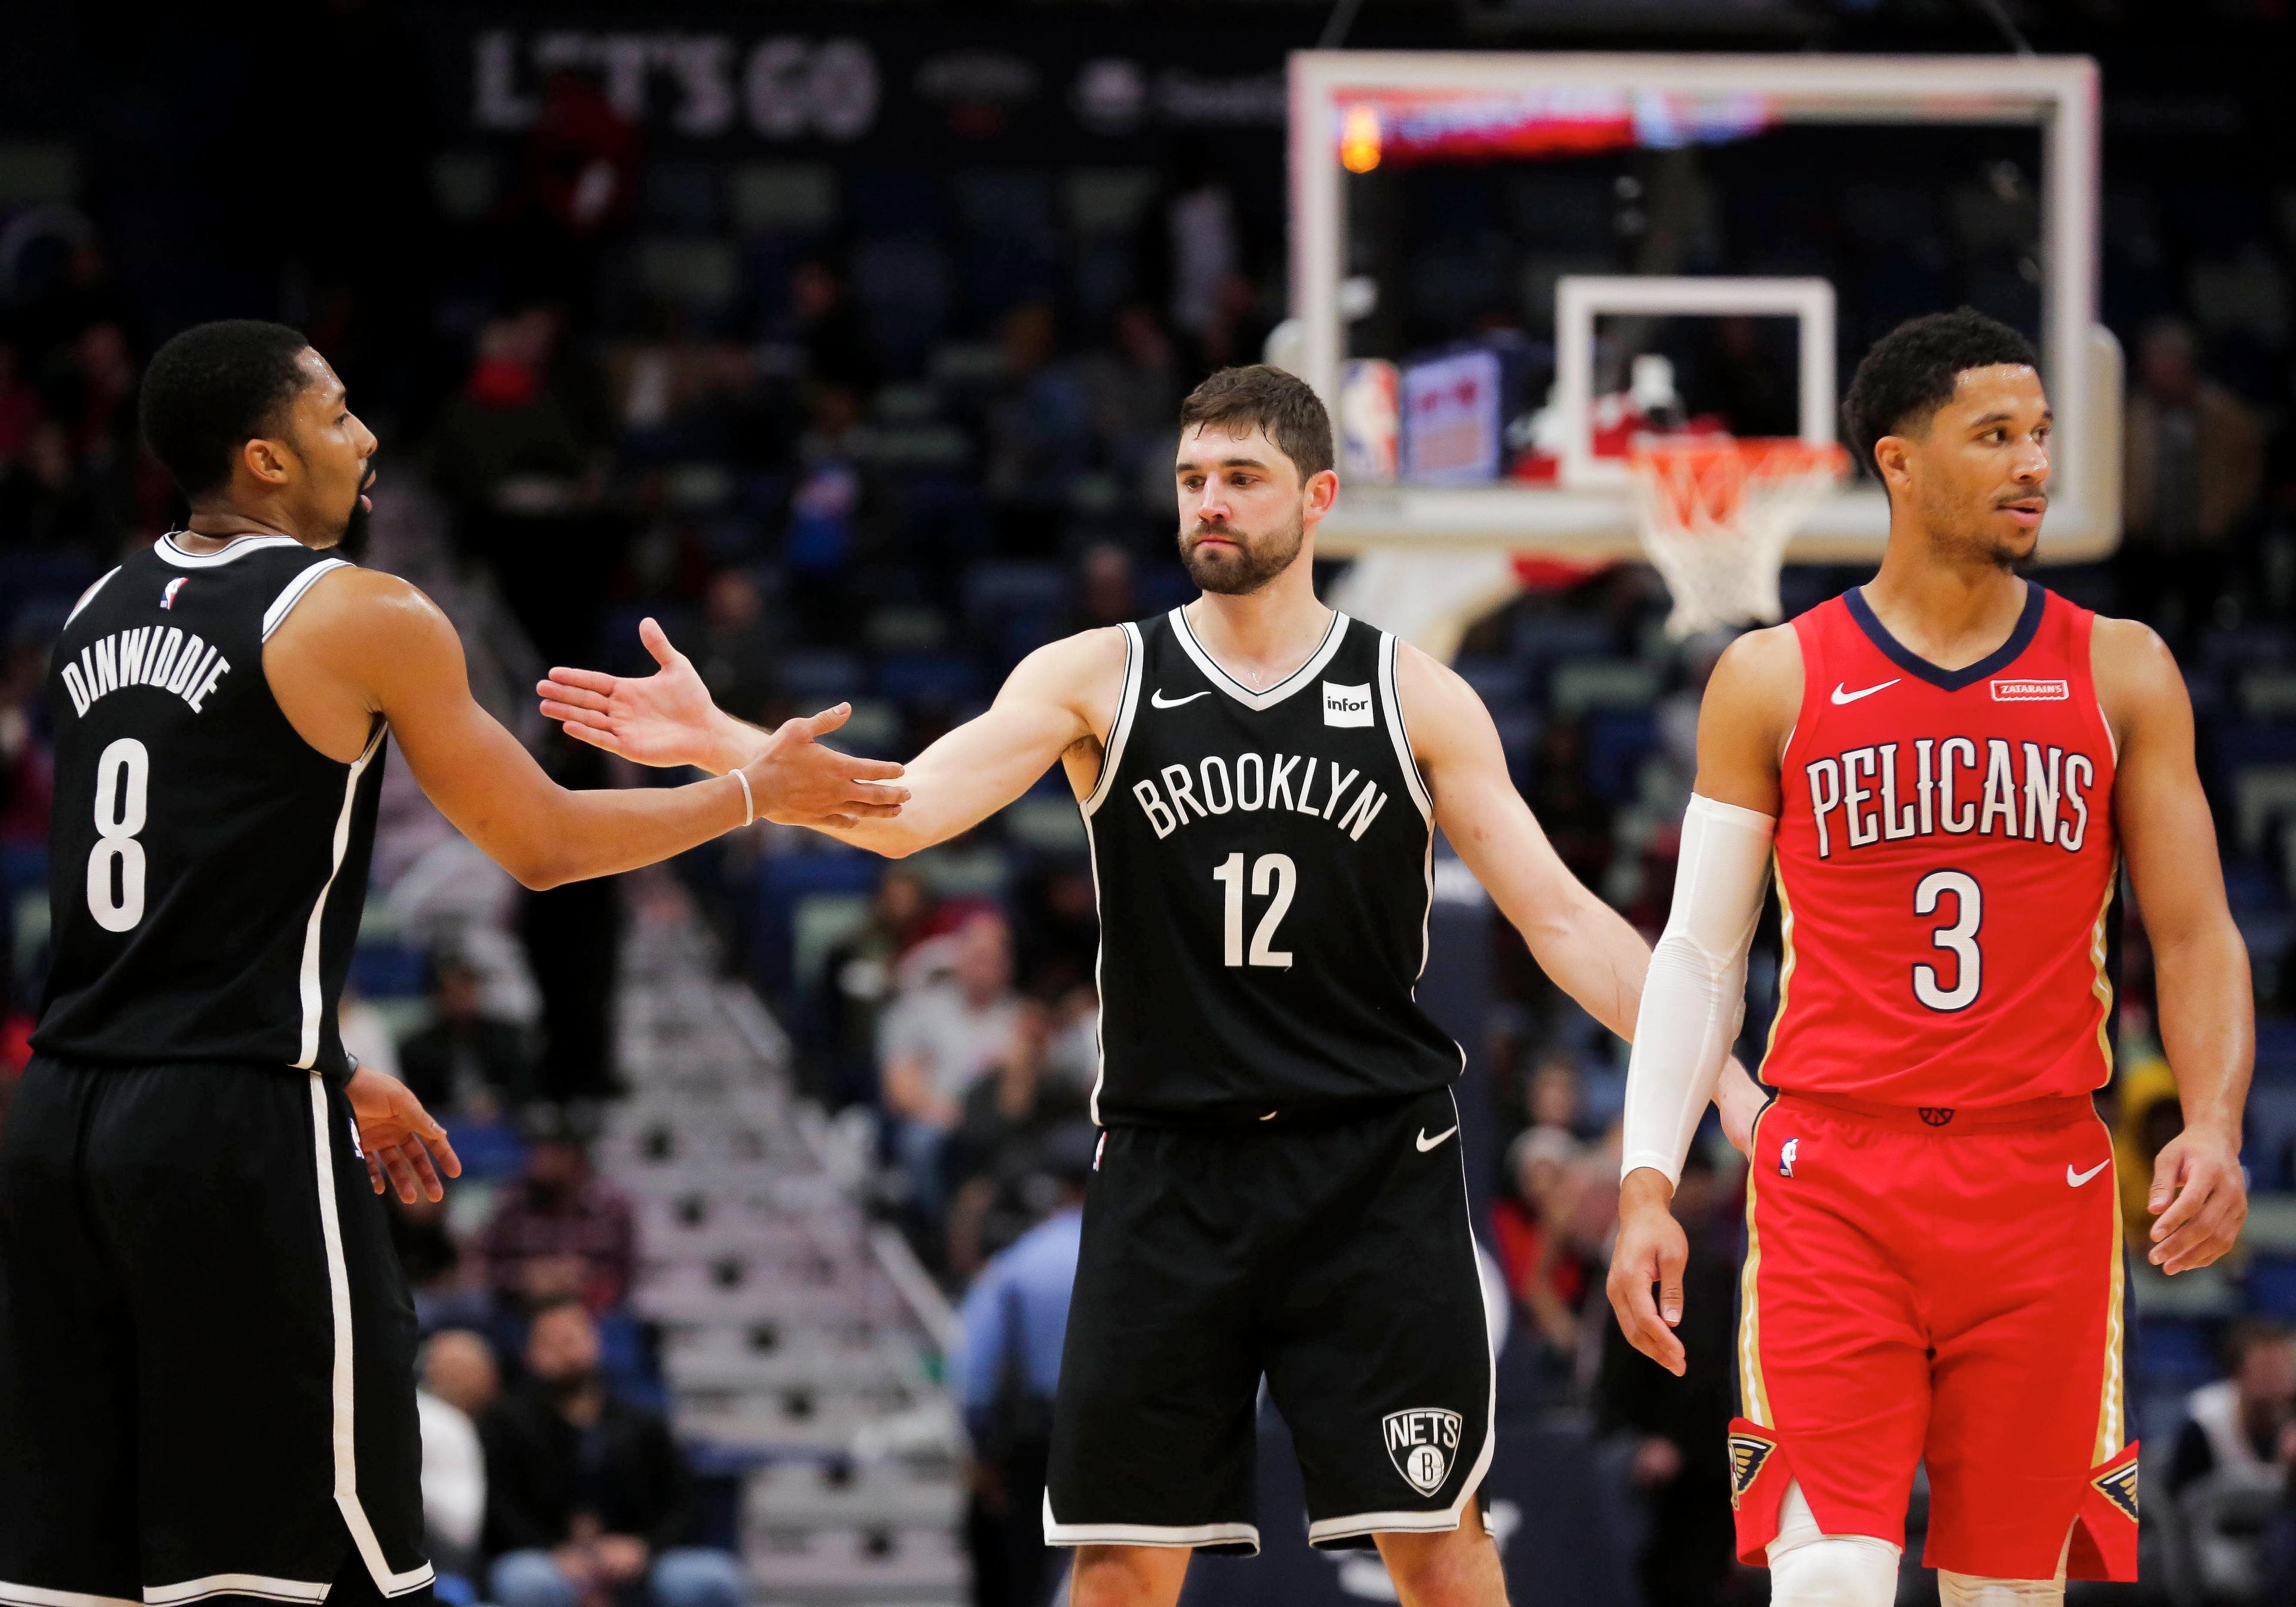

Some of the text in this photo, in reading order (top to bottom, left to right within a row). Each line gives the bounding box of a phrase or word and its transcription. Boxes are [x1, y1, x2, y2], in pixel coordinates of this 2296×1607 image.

[744, 36, 878, 139] GO
[60, 625, 231, 719] DINWIDDIE
[1327, 695, 1369, 712] infor
[2001, 684, 2063, 693] ZATARAIN'S
[86, 738, 149, 933] 8
[1132, 752, 1388, 842] BROOKLYN
[1805, 736, 2095, 859] PELICANS
[1213, 852, 1297, 968] 12
[1912, 869, 1983, 1013] 3
[1390, 1412, 1458, 1451] NETS
[1421, 1452, 1433, 1481] B
